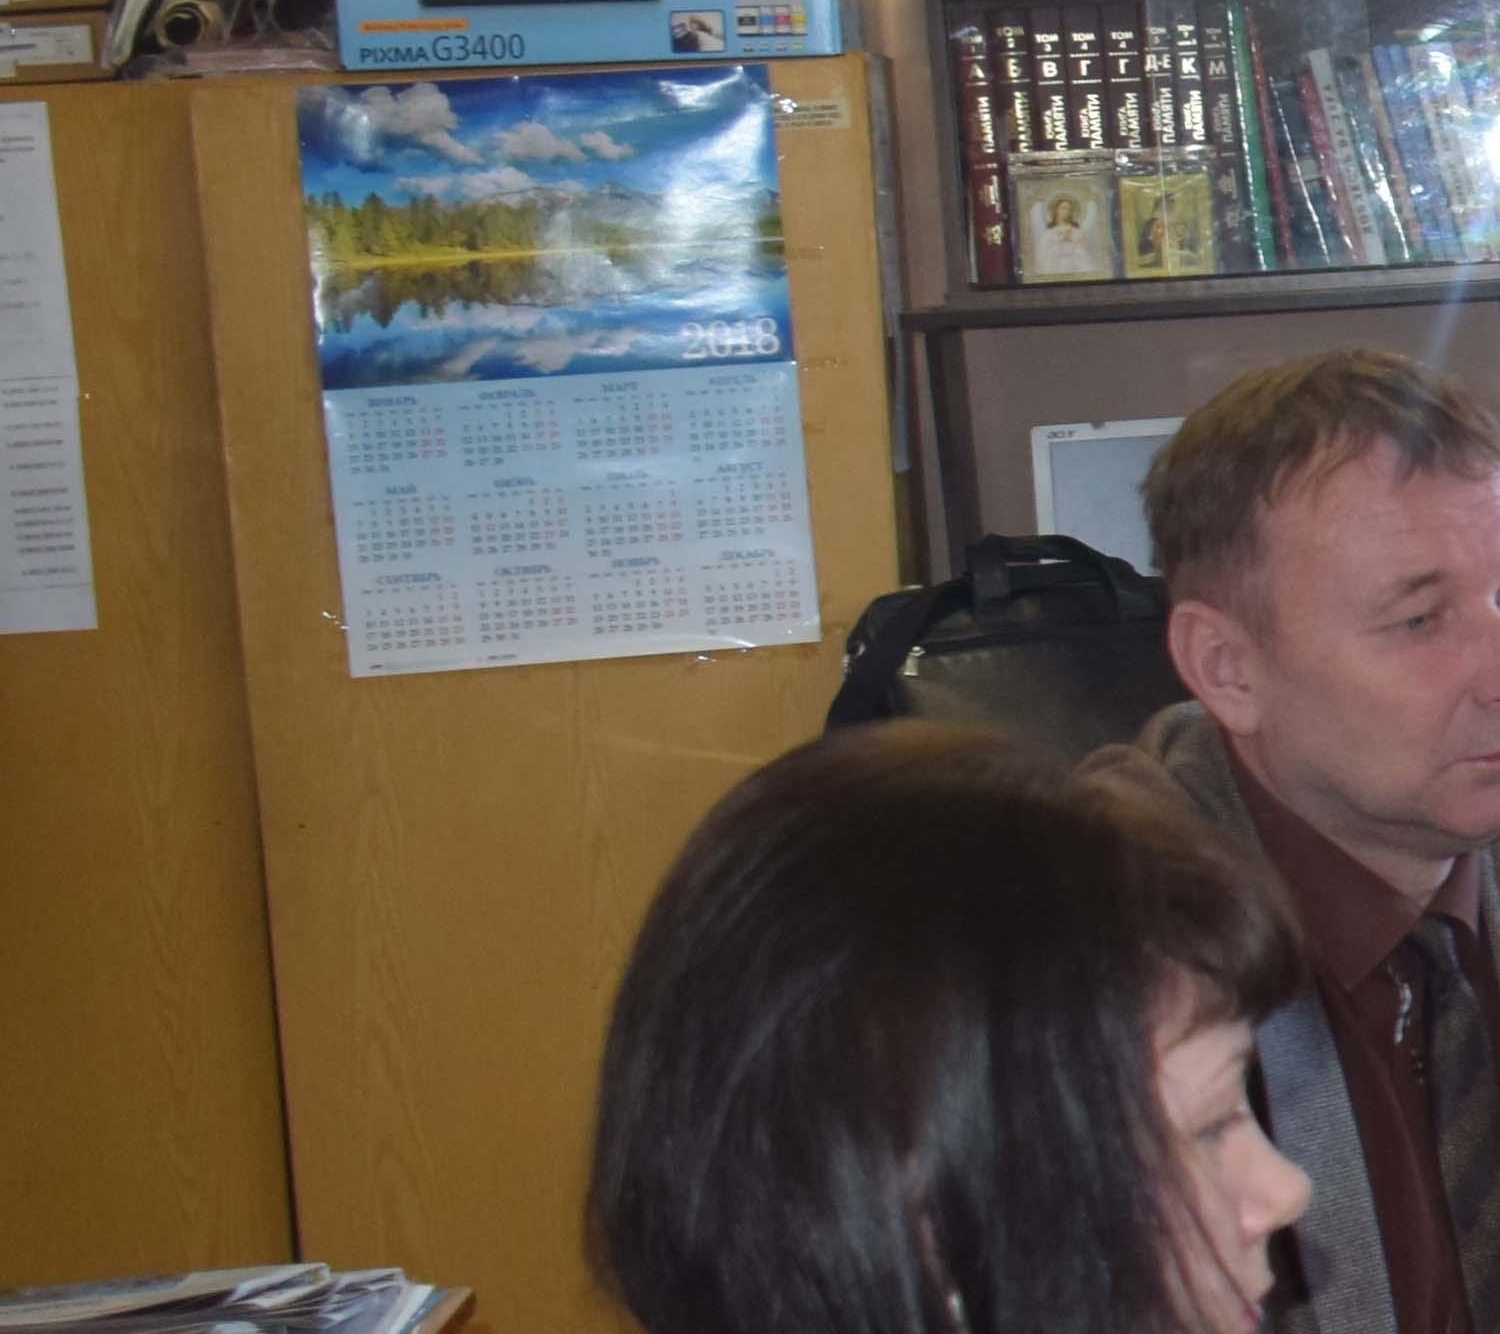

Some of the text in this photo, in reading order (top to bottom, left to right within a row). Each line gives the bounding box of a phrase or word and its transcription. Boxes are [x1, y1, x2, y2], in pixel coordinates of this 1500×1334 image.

[1034, 33, 1060, 43] ТОМ
[1071, 32, 1097, 42] ТОМ
[1110, 31, 1134, 41] ТОМ
[359, 33, 526, 65] PIXMA G3400
[1007, 58, 1022, 79] Б
[1042, 61, 1059, 78] В
[1079, 59, 1092, 77] Г
[1118, 58, 1131, 75] Г
[1181, 56, 1198, 75] К
[1208, 59, 1227, 76] М
[1050, 95, 1069, 151] ПАМЯТИ
[1085, 93, 1104, 150] ПАМЯТИ
[1124, 92, 1142, 149] ПАМЯТИ
[1159, 87, 1176, 144] ПАМЯТИ
[681, 317, 781, 359] 2018
